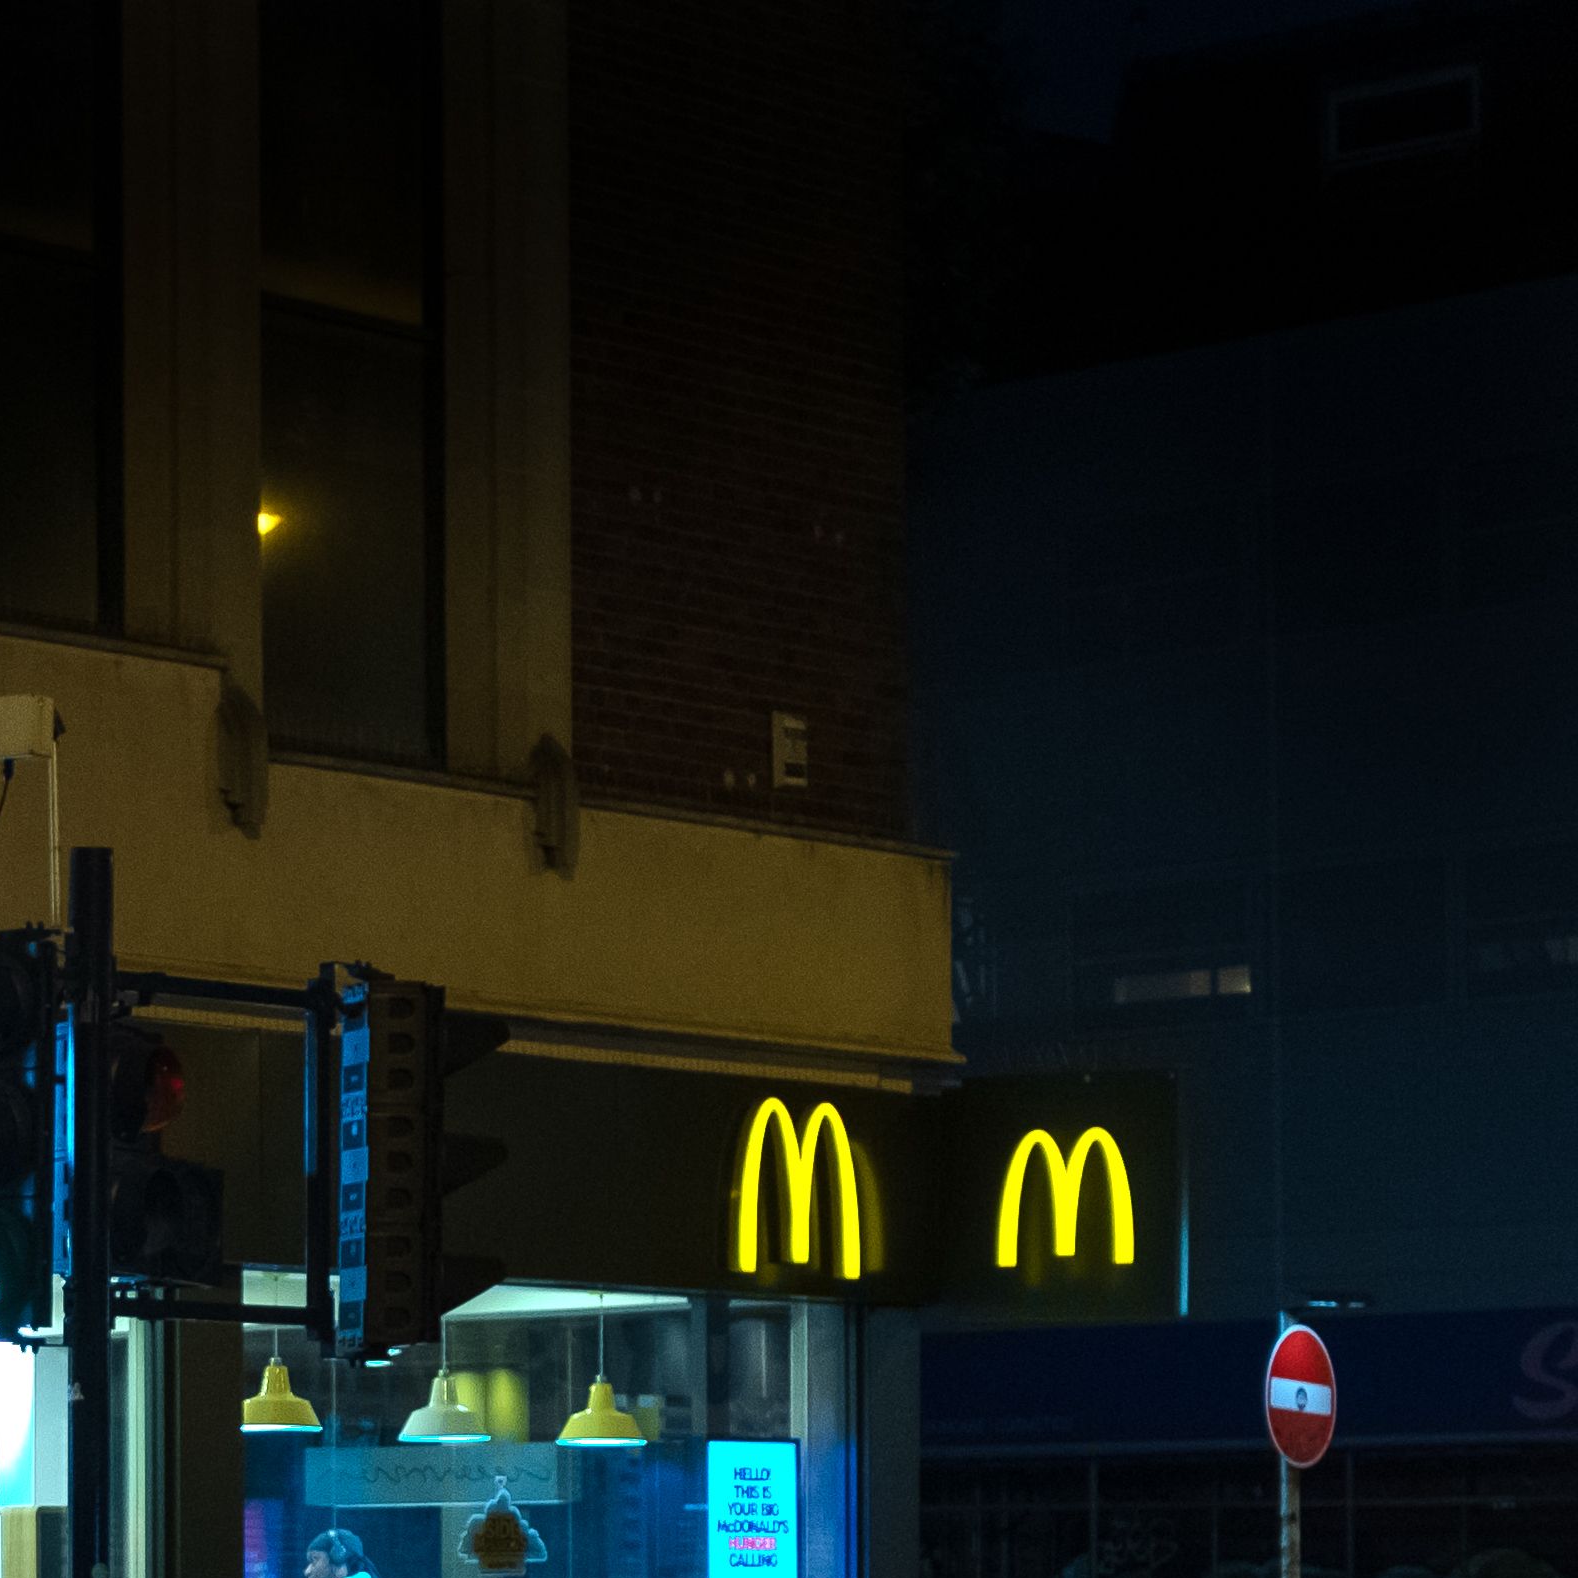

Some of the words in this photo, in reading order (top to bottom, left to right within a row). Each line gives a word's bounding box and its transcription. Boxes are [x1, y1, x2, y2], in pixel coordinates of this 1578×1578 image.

[734, 1485, 759, 1499] THIS
[762, 1485, 772, 1499] IS
[728, 1502, 757, 1515] YOUR
[762, 1503, 779, 1516] BIG
[717, 1520, 789, 1534] McDONALD'S
[729, 1536, 776, 1550] HUNGER
[730, 1553, 778, 1567] CALLING
